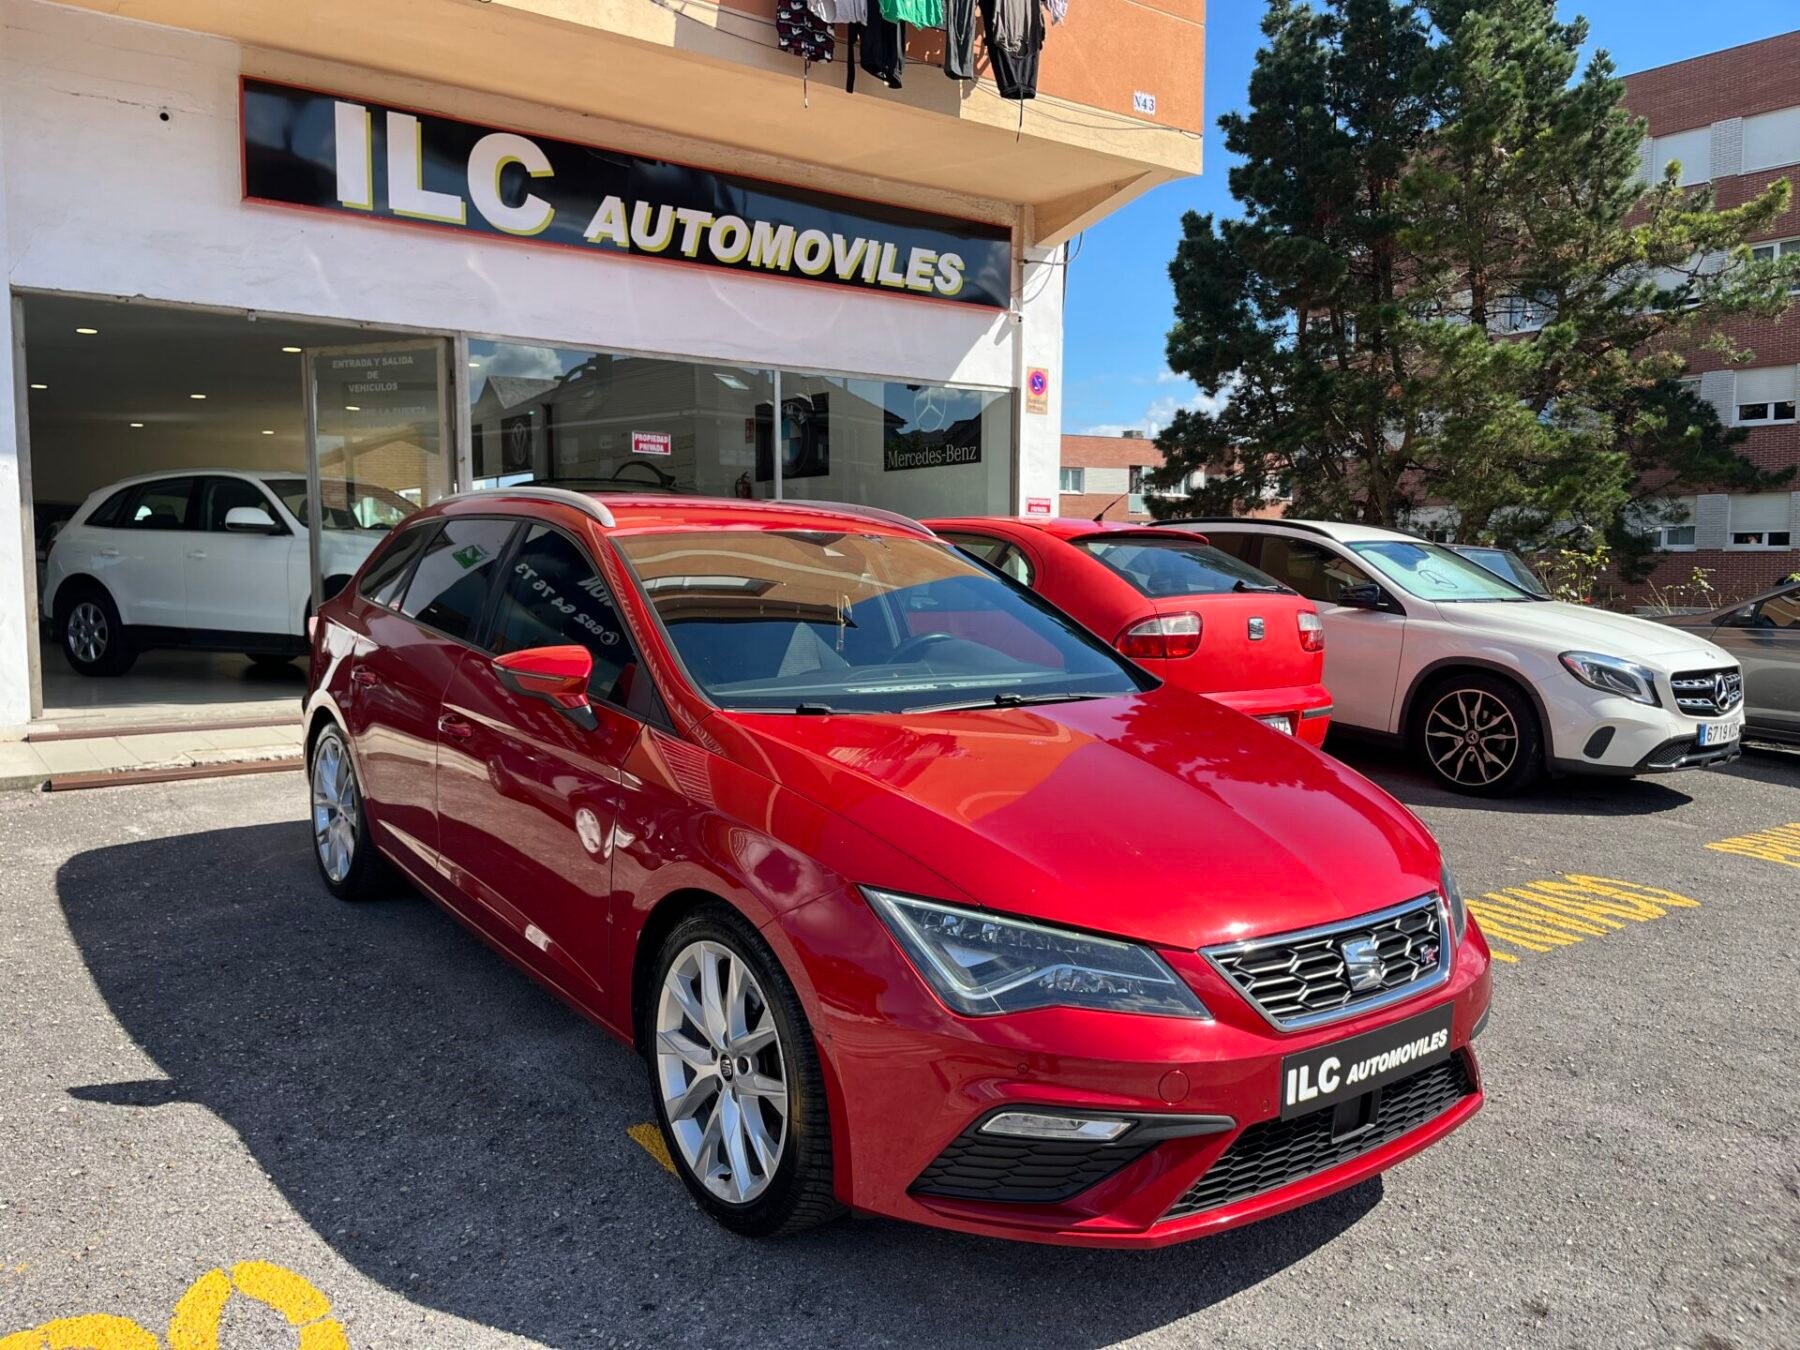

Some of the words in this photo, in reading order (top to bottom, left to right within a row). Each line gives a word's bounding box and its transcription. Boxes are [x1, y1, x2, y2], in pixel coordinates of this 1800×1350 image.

[334, 100, 555, 235] ILC
[583, 195, 965, 296] AUTOMOVILES
[332, 358, 373, 369] ENTRADA
[372, 358, 380, 366] Y
[382, 356, 414, 366] SALIDA
[367, 370, 379, 380] DE
[348, 382, 398, 393] VEHICULOS
[635, 434, 669, 444] PROPIEDAD
[638, 443, 665, 452] PRIVADA
[888, 444, 977, 469] Mercedes-Benz
[1707, 724, 1728, 742] 6719
[1286, 1056, 1341, 1106] ILC
[1345, 1028, 1449, 1086] AUTOMOVILES
